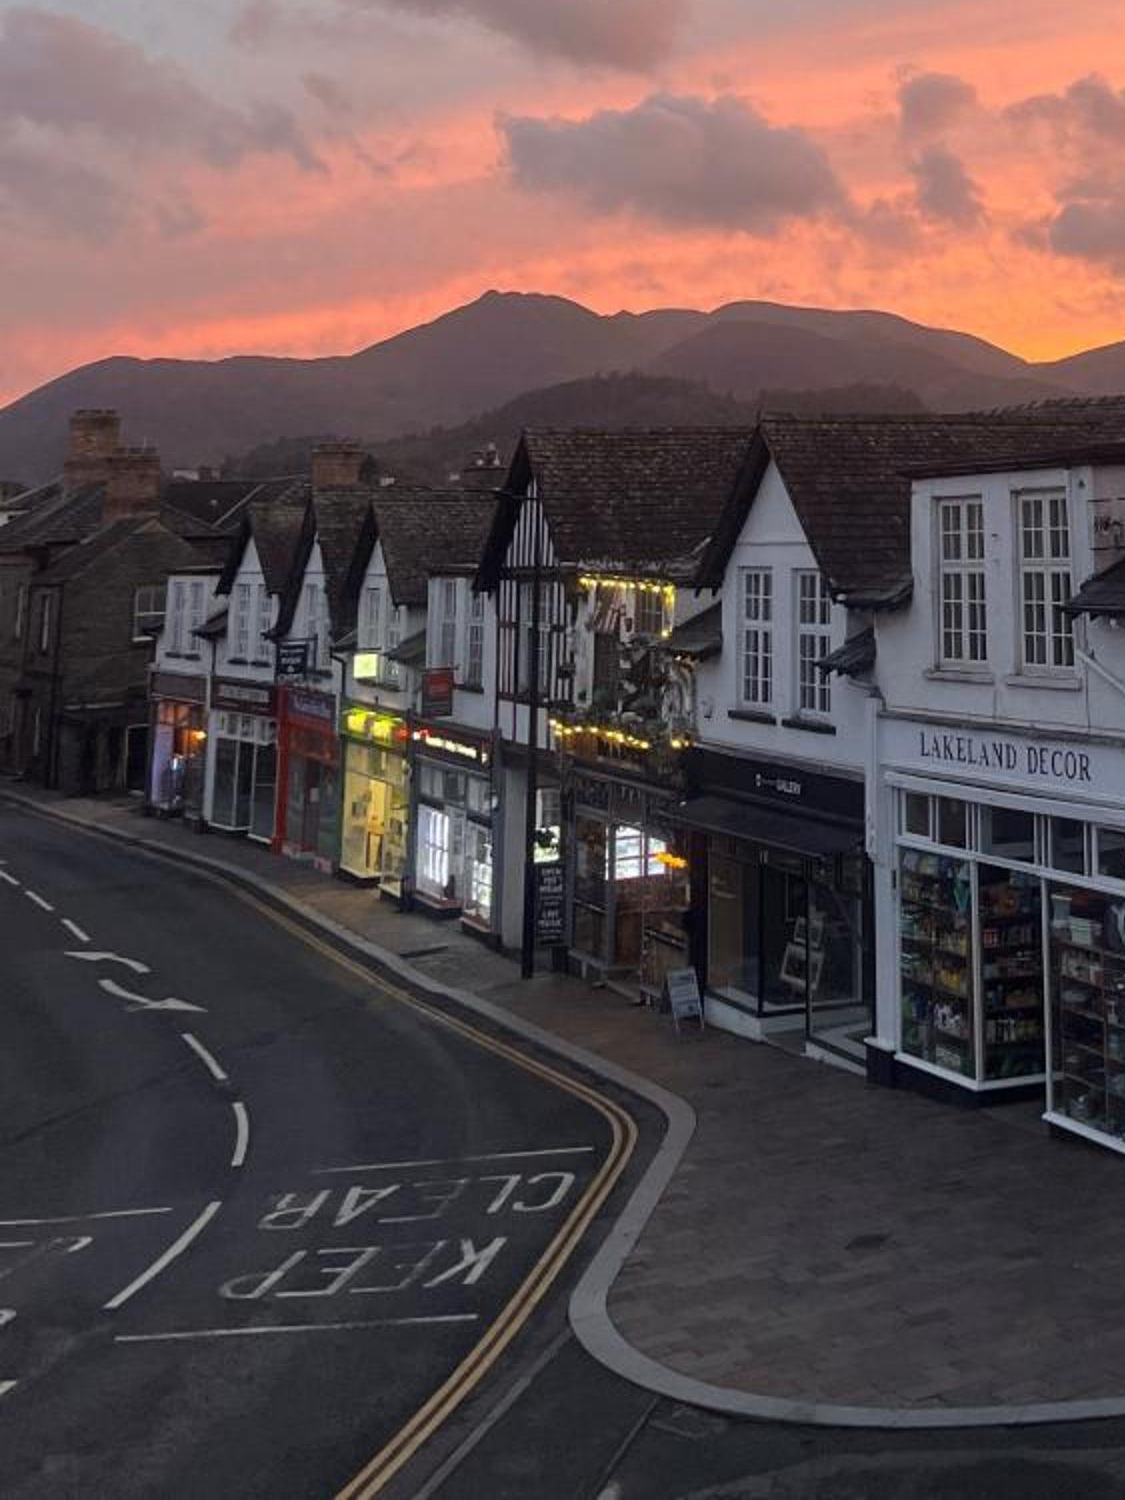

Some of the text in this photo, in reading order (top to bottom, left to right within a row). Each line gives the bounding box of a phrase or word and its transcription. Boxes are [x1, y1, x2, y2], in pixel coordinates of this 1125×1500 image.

[920, 731, 1091, 782] LAKELAND DECOR
[257, 1172, 576, 1230] CLEAR
[218, 1236, 508, 1300] KEEP
